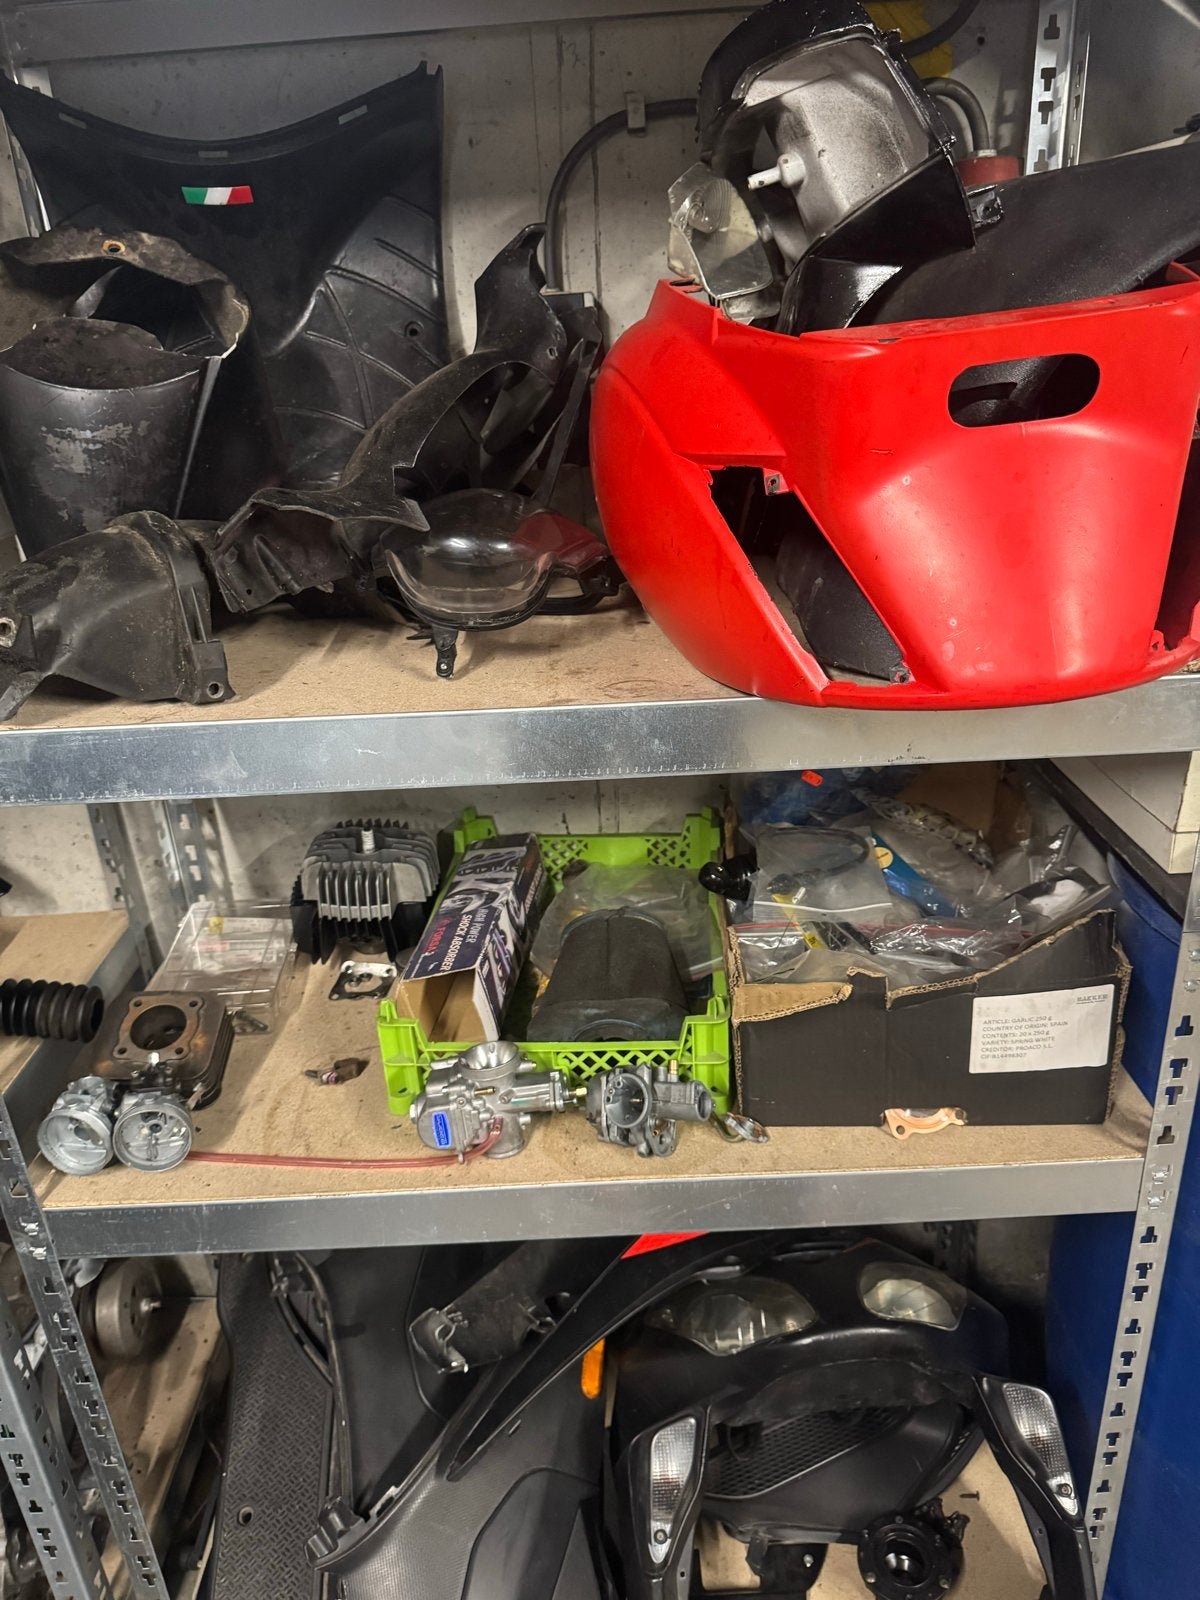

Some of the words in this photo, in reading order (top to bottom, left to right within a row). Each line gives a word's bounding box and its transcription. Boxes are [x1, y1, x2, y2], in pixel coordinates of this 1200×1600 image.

[456, 914, 473, 936] SHOCK
[465, 922, 484, 943] POWER
[439, 935, 464, 971] ABSORBER
[1011, 1016, 1034, 1024] GARLIC
